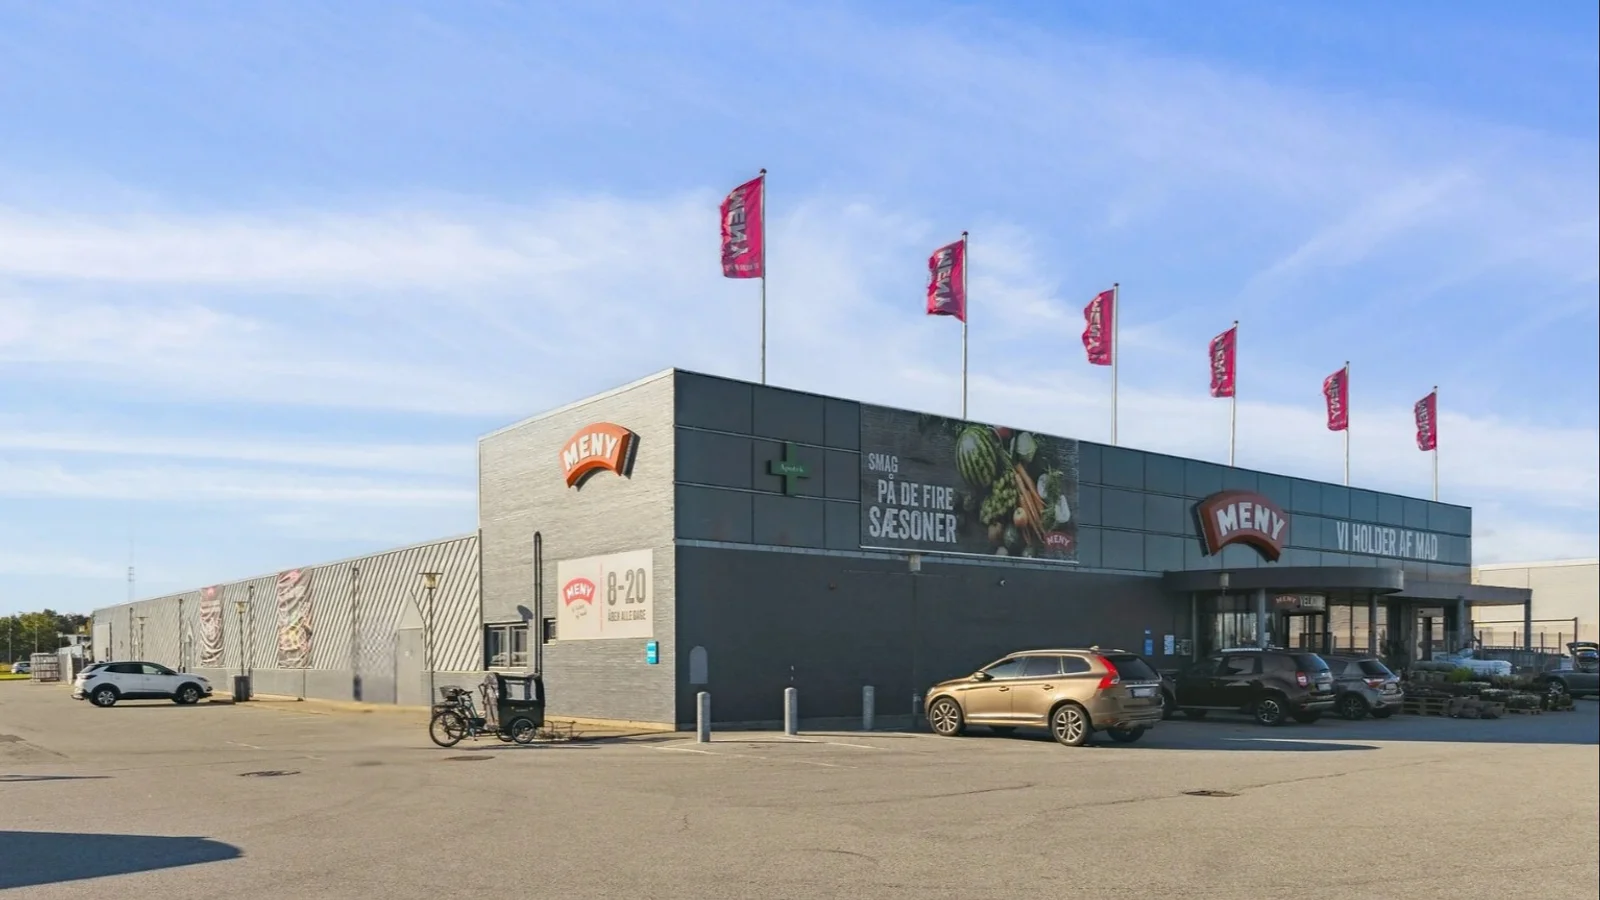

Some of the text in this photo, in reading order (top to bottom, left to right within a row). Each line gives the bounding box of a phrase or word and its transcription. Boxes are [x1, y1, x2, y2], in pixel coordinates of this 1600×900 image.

[563, 432, 618, 472] MENY
[868, 453, 899, 473] SMAG
[877, 474, 953, 510] PÅ DE FIRE
[869, 506, 957, 543] SÆSONER
[1216, 502, 1285, 540] MENY
[1046, 534, 1071, 546] MENY
[1336, 521, 1438, 560] VI HOLDER AF MAD
[566, 582, 592, 599] MENY
[607, 567, 646, 606] 8-20
